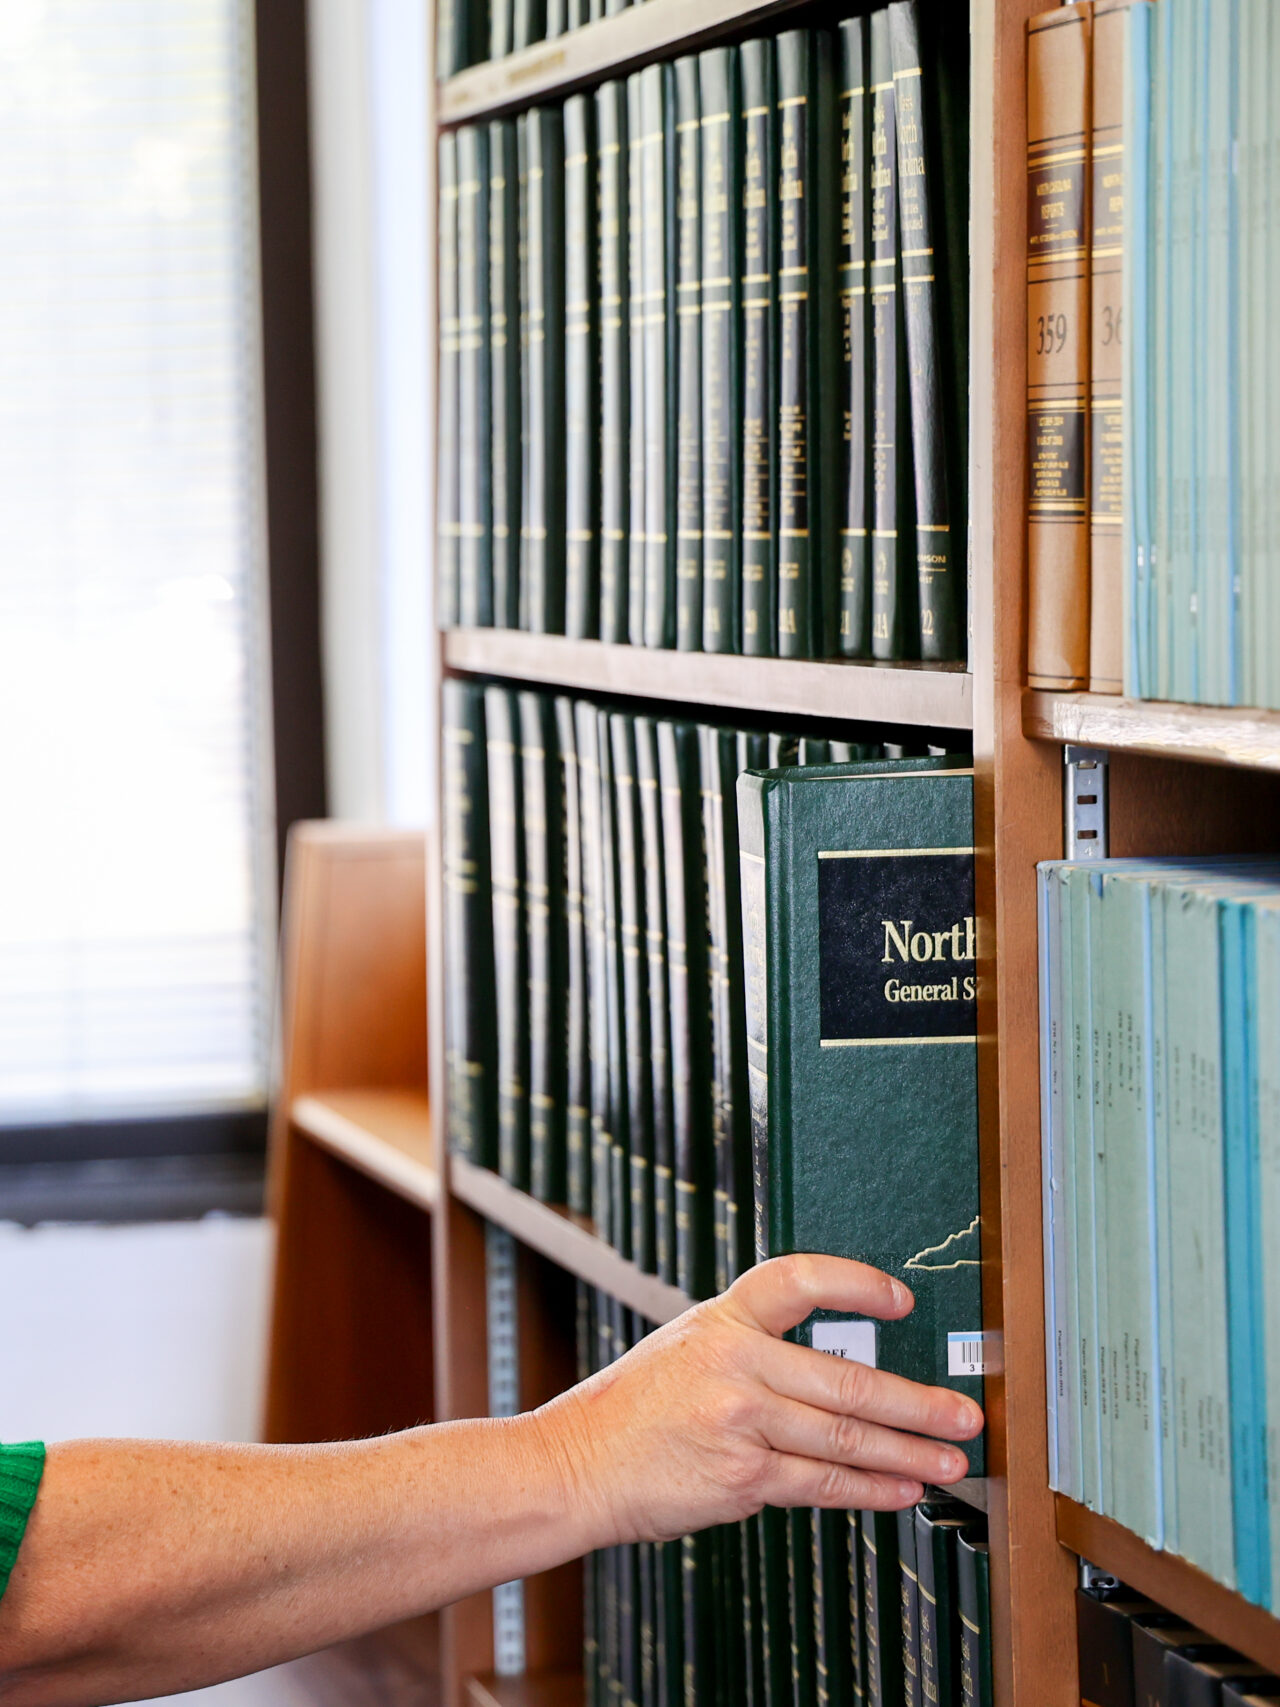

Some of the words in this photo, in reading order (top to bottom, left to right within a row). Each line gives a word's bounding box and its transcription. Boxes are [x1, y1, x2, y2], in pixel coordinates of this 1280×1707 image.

[1036, 313, 1067, 355] 359
[1101, 306, 1123, 346] 36
[921, 609, 934, 636] 22
[884, 977, 959, 1003] General
[969, 1363, 976, 1373] 3
